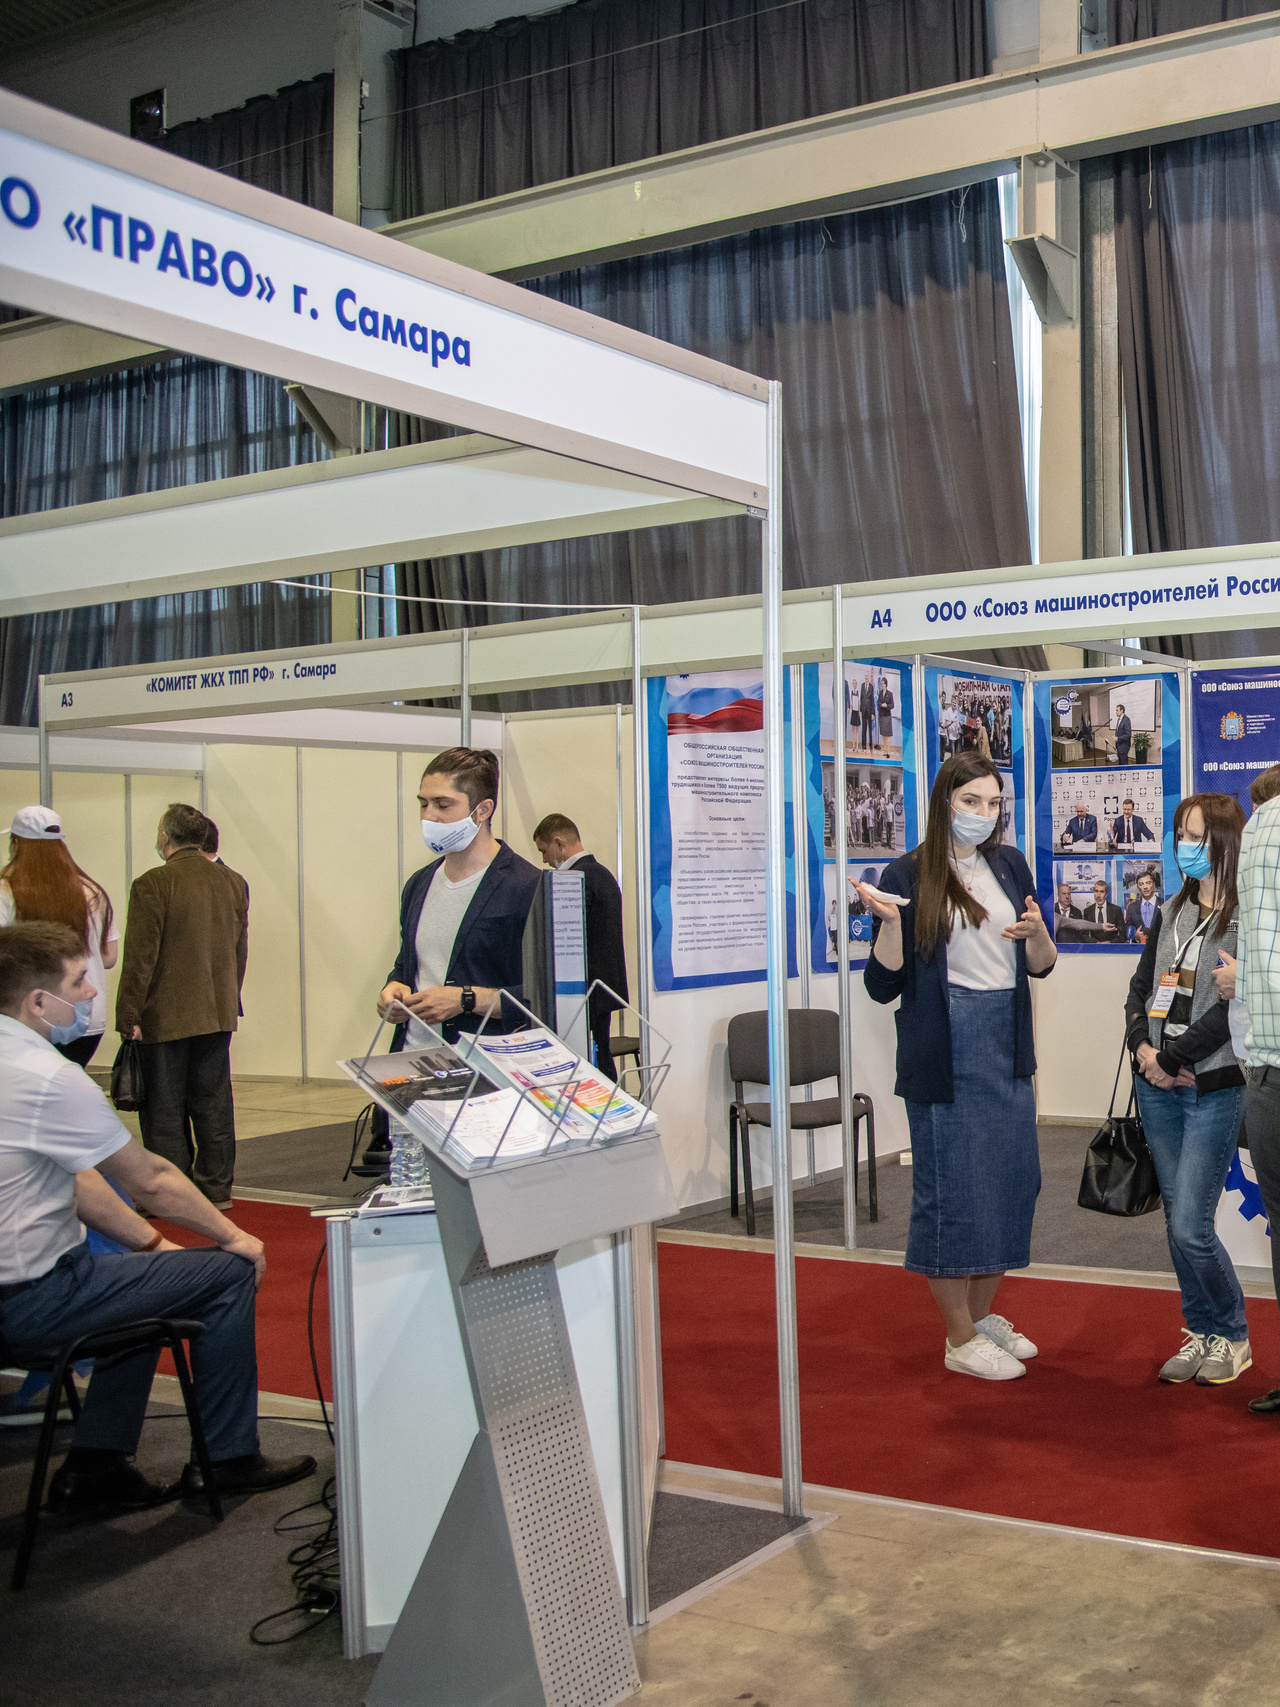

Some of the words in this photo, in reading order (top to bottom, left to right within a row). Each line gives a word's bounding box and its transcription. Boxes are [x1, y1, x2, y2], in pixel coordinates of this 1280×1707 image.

[62, 203, 276, 303] «ПРАВО»
[293, 284, 319, 321] г.
[335, 288, 471, 369] Самара
[925, 600, 967, 622] ООО
[973, 598, 1028, 618] «Союз
[1034, 578, 1219, 614] машиностроителей
[870, 609, 893, 628] А4
[146, 674, 197, 693] «КОМИТЕТ
[200, 671, 225, 689] ЖКХ
[228, 668, 249, 685] ТПП
[253, 665, 274, 682] РФ»
[282, 668, 290, 679] г.
[294, 662, 336, 680] Самара
[1201, 683, 1217, 693] ООО
[1218, 681, 1243, 692] «Союз
[61, 692, 73, 707] А3
[684, 743, 727, 751] ОБЩЕРОССИЙСКАЯ
[728, 746, 764, 754] ОБЩЕСТВЕННАЯ
[707, 752, 742, 760] ОРГАНИЗАЦИЯ
[1203, 762, 1218, 772] ООО
[1219, 761, 1244, 771] «Союз
